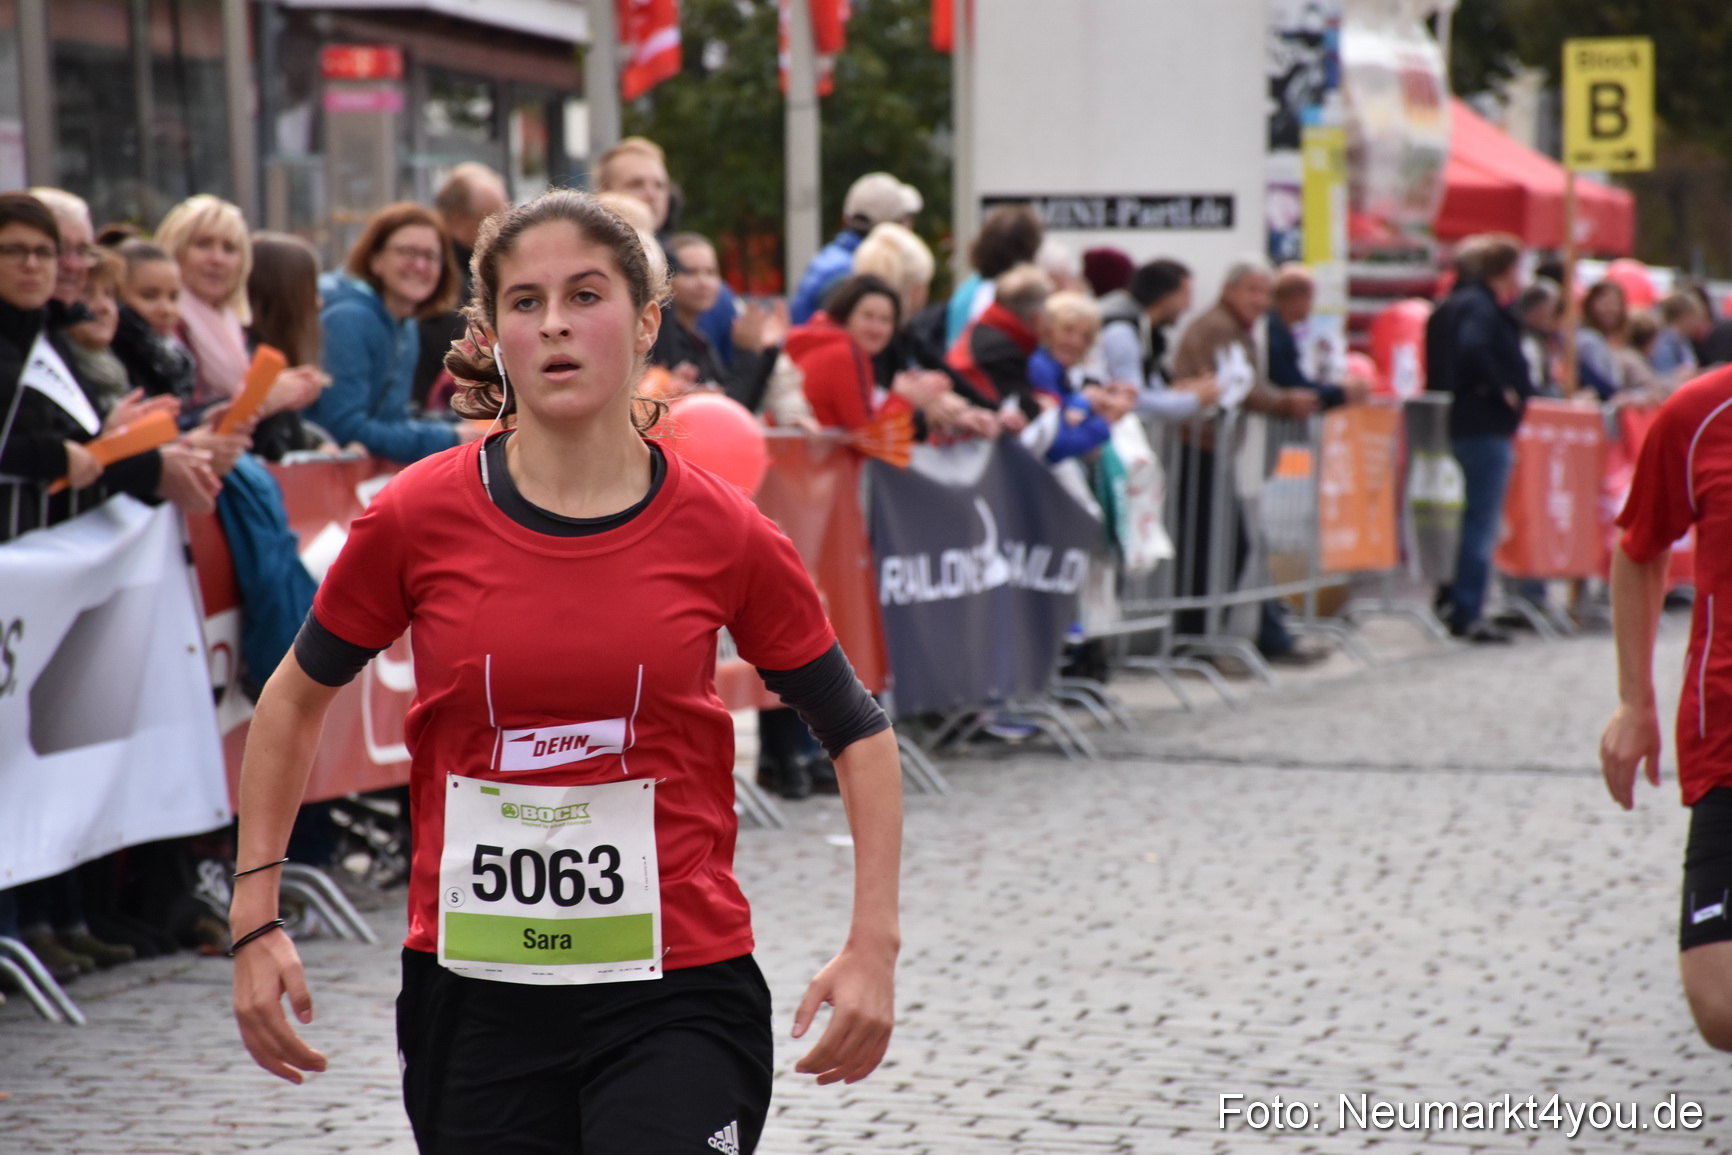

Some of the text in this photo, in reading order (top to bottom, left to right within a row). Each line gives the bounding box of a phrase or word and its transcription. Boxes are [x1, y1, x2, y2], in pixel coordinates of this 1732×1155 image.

[1589, 82, 1629, 140] B
[533, 735, 590, 757] DEHN
[521, 803, 590, 823] BOCK
[472, 844, 624, 907] 5063
[451, 892, 459, 903] S
[523, 928, 572, 950] Sara
[708, 1137, 739, 1155] adid
